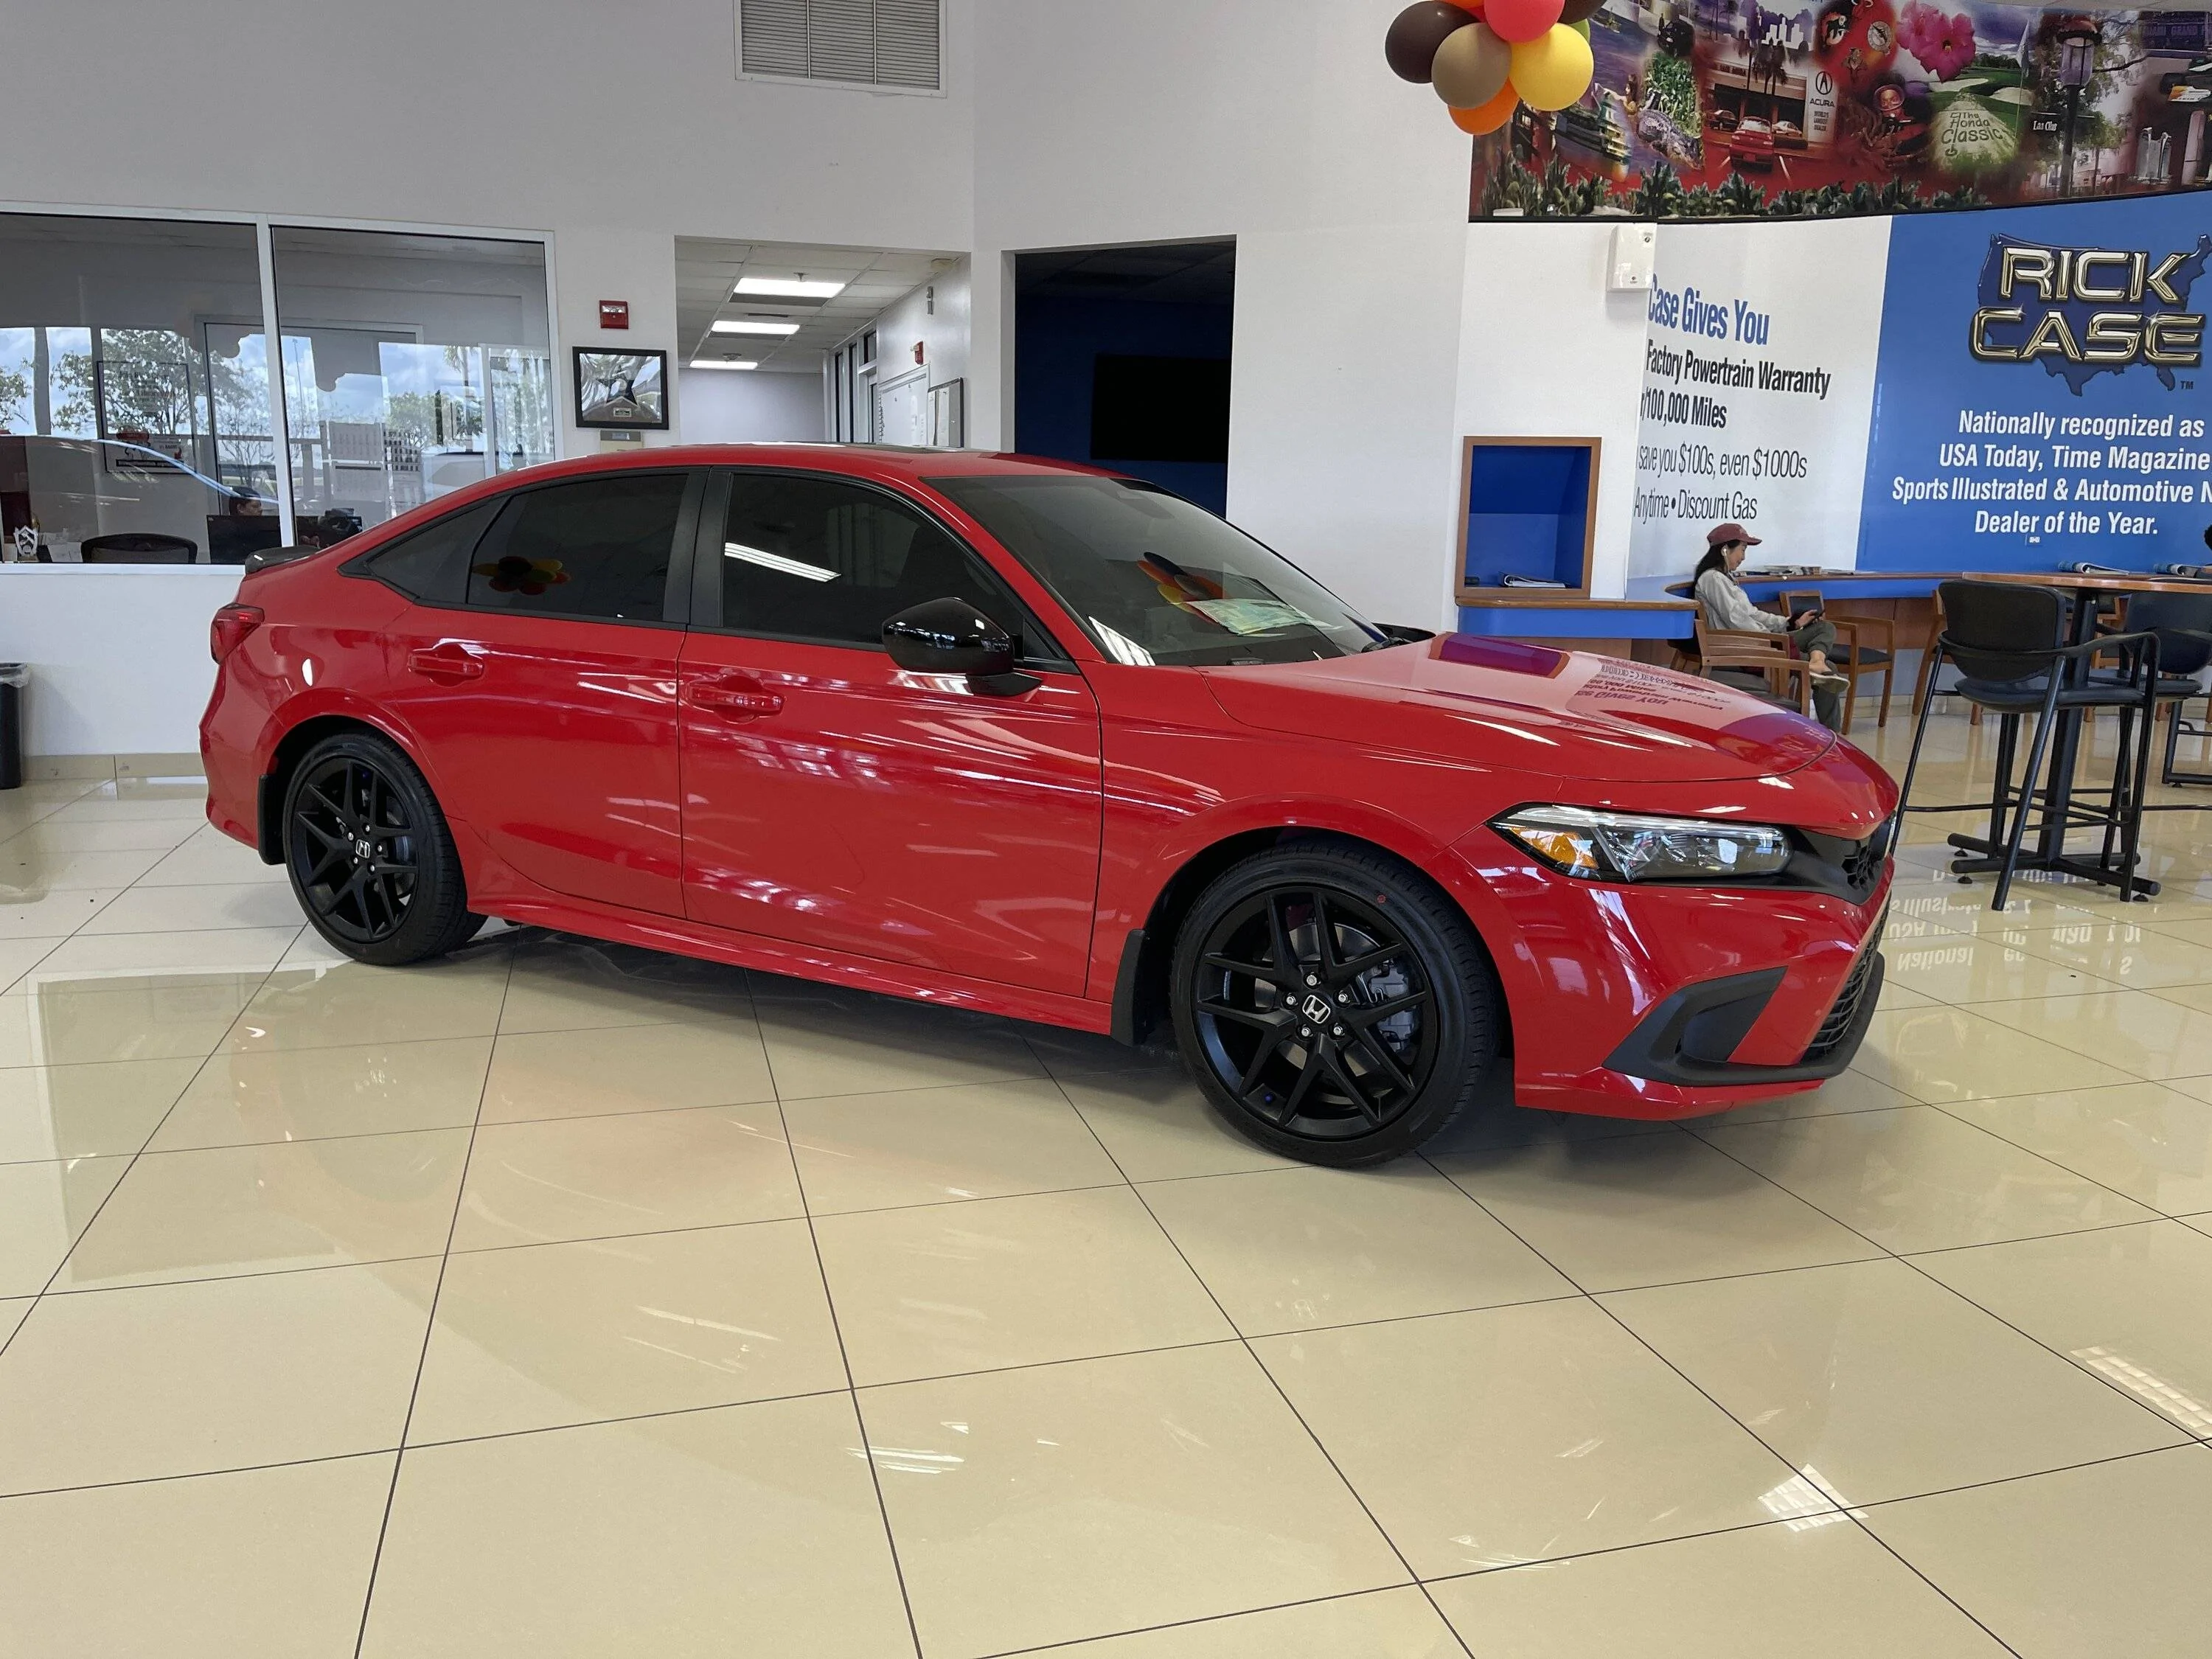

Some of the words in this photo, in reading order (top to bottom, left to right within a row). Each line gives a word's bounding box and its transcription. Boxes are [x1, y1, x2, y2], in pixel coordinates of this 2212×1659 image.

[1810, 98, 1834, 107] ACURA
[1941, 128, 2003, 145] Classic
[1950, 117, 1990, 128] Honda
[1999, 246, 2191, 304] RICK
[1682, 287, 1728, 339] Gives
[1734, 299, 1770, 345] You
[1969, 306, 2206, 366] CASE
[1646, 338, 1683, 385] Factory
[1684, 349, 1754, 389] Powertrain
[1759, 360, 1832, 400] Warranty
[1691, 395, 1728, 428] Miles
[1958, 409, 2056, 440] Nationally
[2060, 414, 2174, 440] recognized
[2179, 419, 2205, 437] as
[1638, 445, 1658, 470] save
[1657, 447, 1676, 478] you
[1678, 440, 1716, 479] $100s,
[1719, 452, 1750, 476] even
[1752, 446, 1807, 479] $1000s
[1939, 443, 1978, 467] USA
[1983, 444, 2043, 473] Today,
[2052, 445, 2101, 468] Time
[2107, 446, 2211, 474] Magazine
[1634, 486, 1669, 524] Anytime
[1677, 488, 1730, 519] Discount
[1732, 490, 1757, 519] Gas
[1892, 476, 1950, 505] Sports
[1951, 477, 2048, 501] Illustrated
[2053, 478, 2069, 501] &
[2074, 479, 2194, 503] Automotive
[1975, 510, 2039, 534] Dealer
[2044, 511, 2065, 533] of
[2069, 511, 2101, 534] the
[2107, 511, 2159, 535] Year.
